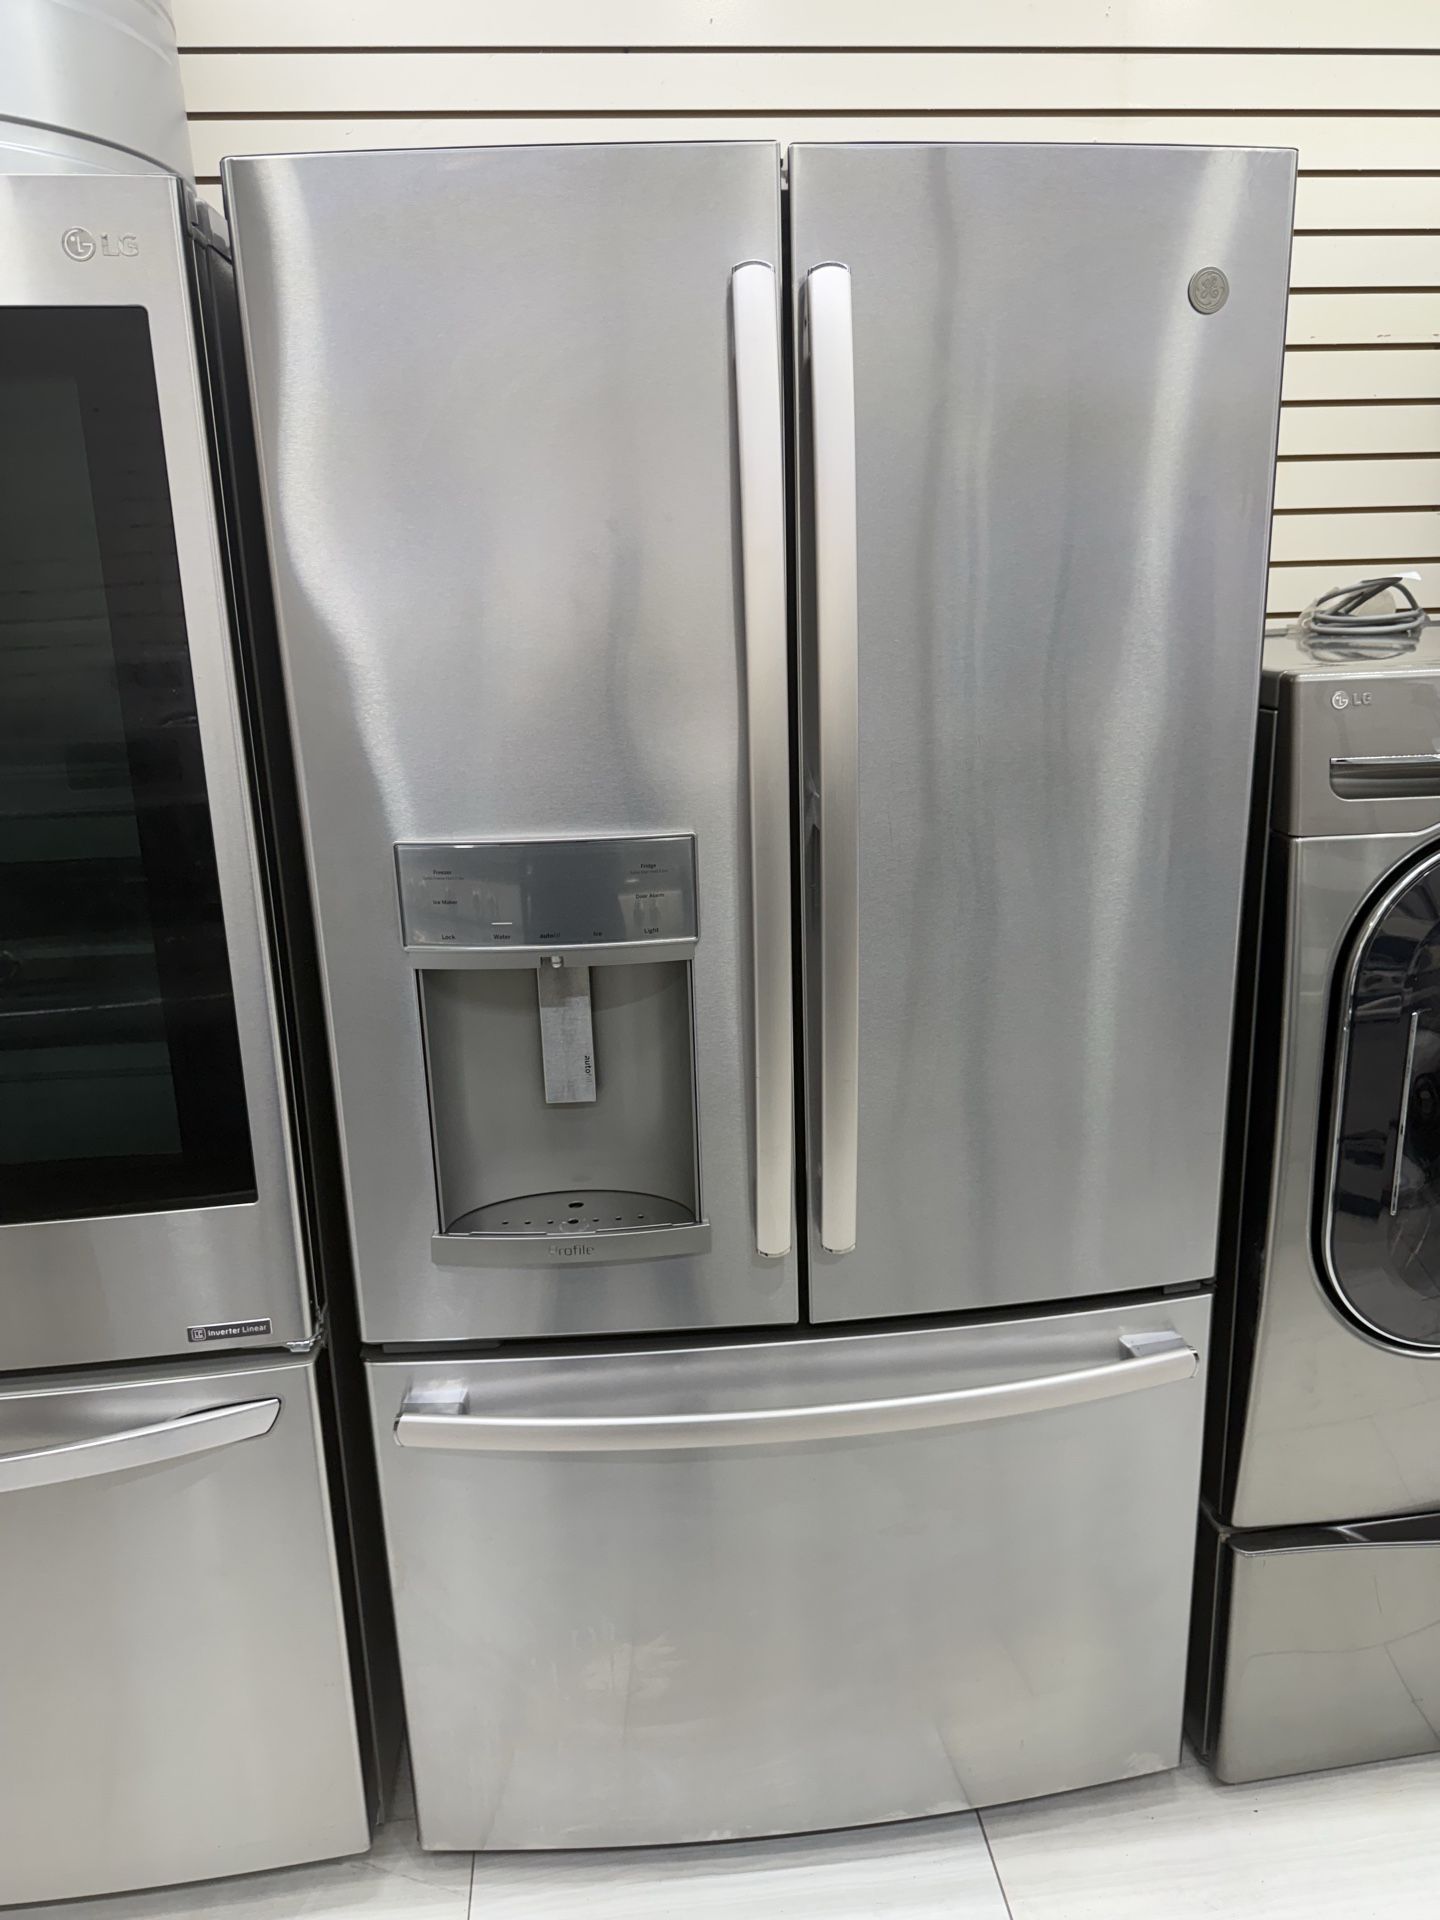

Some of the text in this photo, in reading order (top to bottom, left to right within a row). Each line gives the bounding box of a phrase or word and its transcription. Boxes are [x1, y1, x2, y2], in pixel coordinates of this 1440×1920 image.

[101, 233, 139, 257] LG
[1352, 692, 1372, 706] LG
[643, 927, 660, 935] Light
[242, 1324, 267, 1333] Linear
